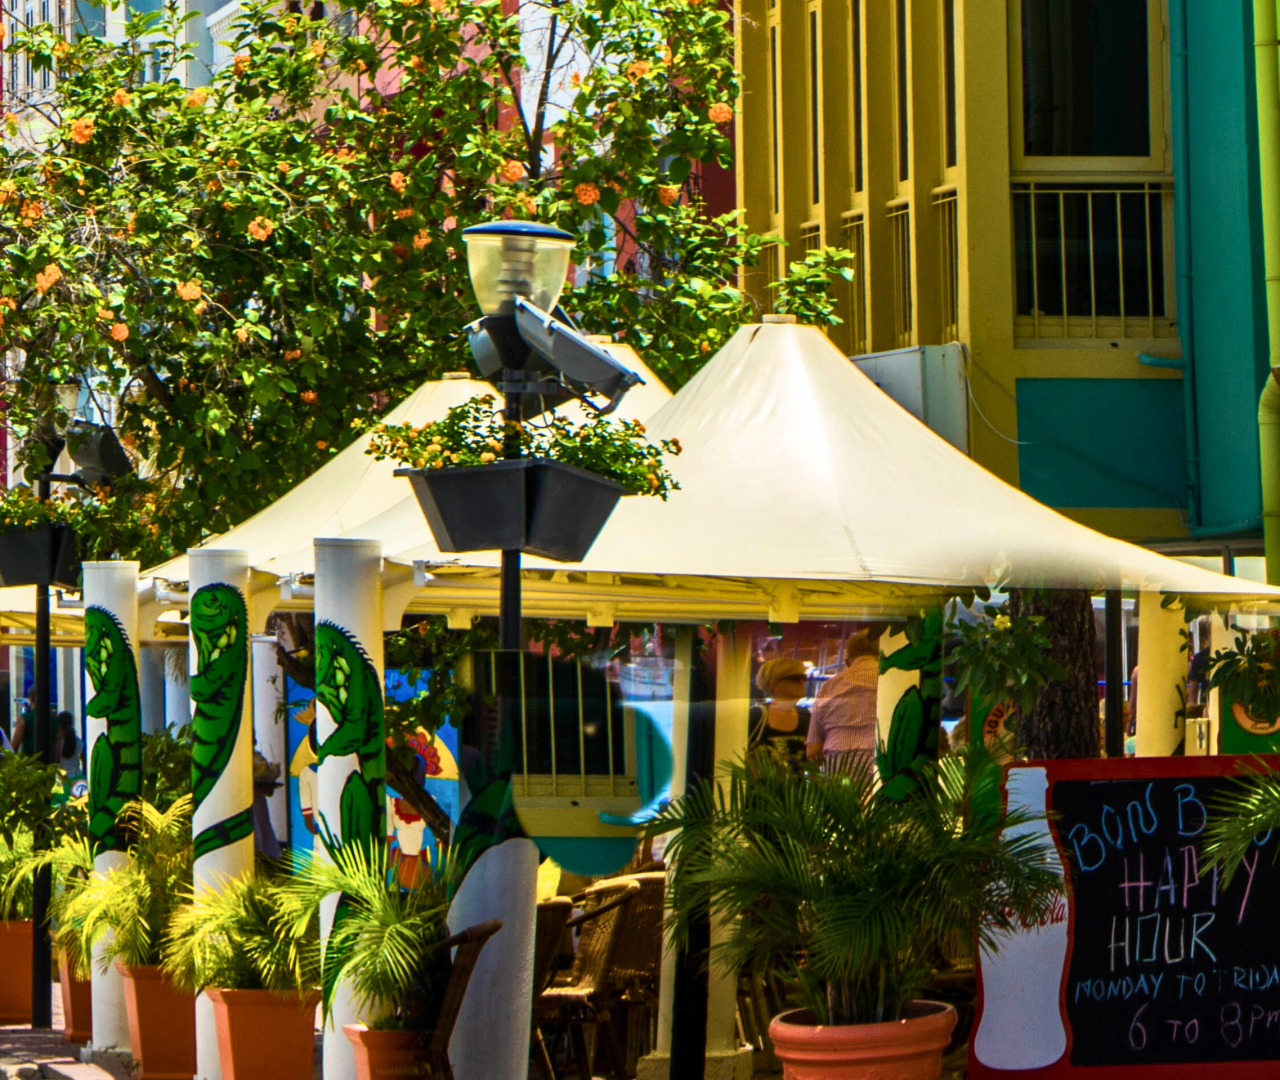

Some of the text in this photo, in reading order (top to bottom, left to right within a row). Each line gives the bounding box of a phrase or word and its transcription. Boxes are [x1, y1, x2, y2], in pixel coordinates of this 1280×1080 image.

[1068, 782, 1158, 872] BON
[1108, 912, 1217, 972] HOUR
[1075, 972, 1164, 1004] MONDAY
[1176, 972, 1206, 1000] TO
[1129, 1002, 1150, 1050] 6
[1166, 1018, 1199, 1044] TO
